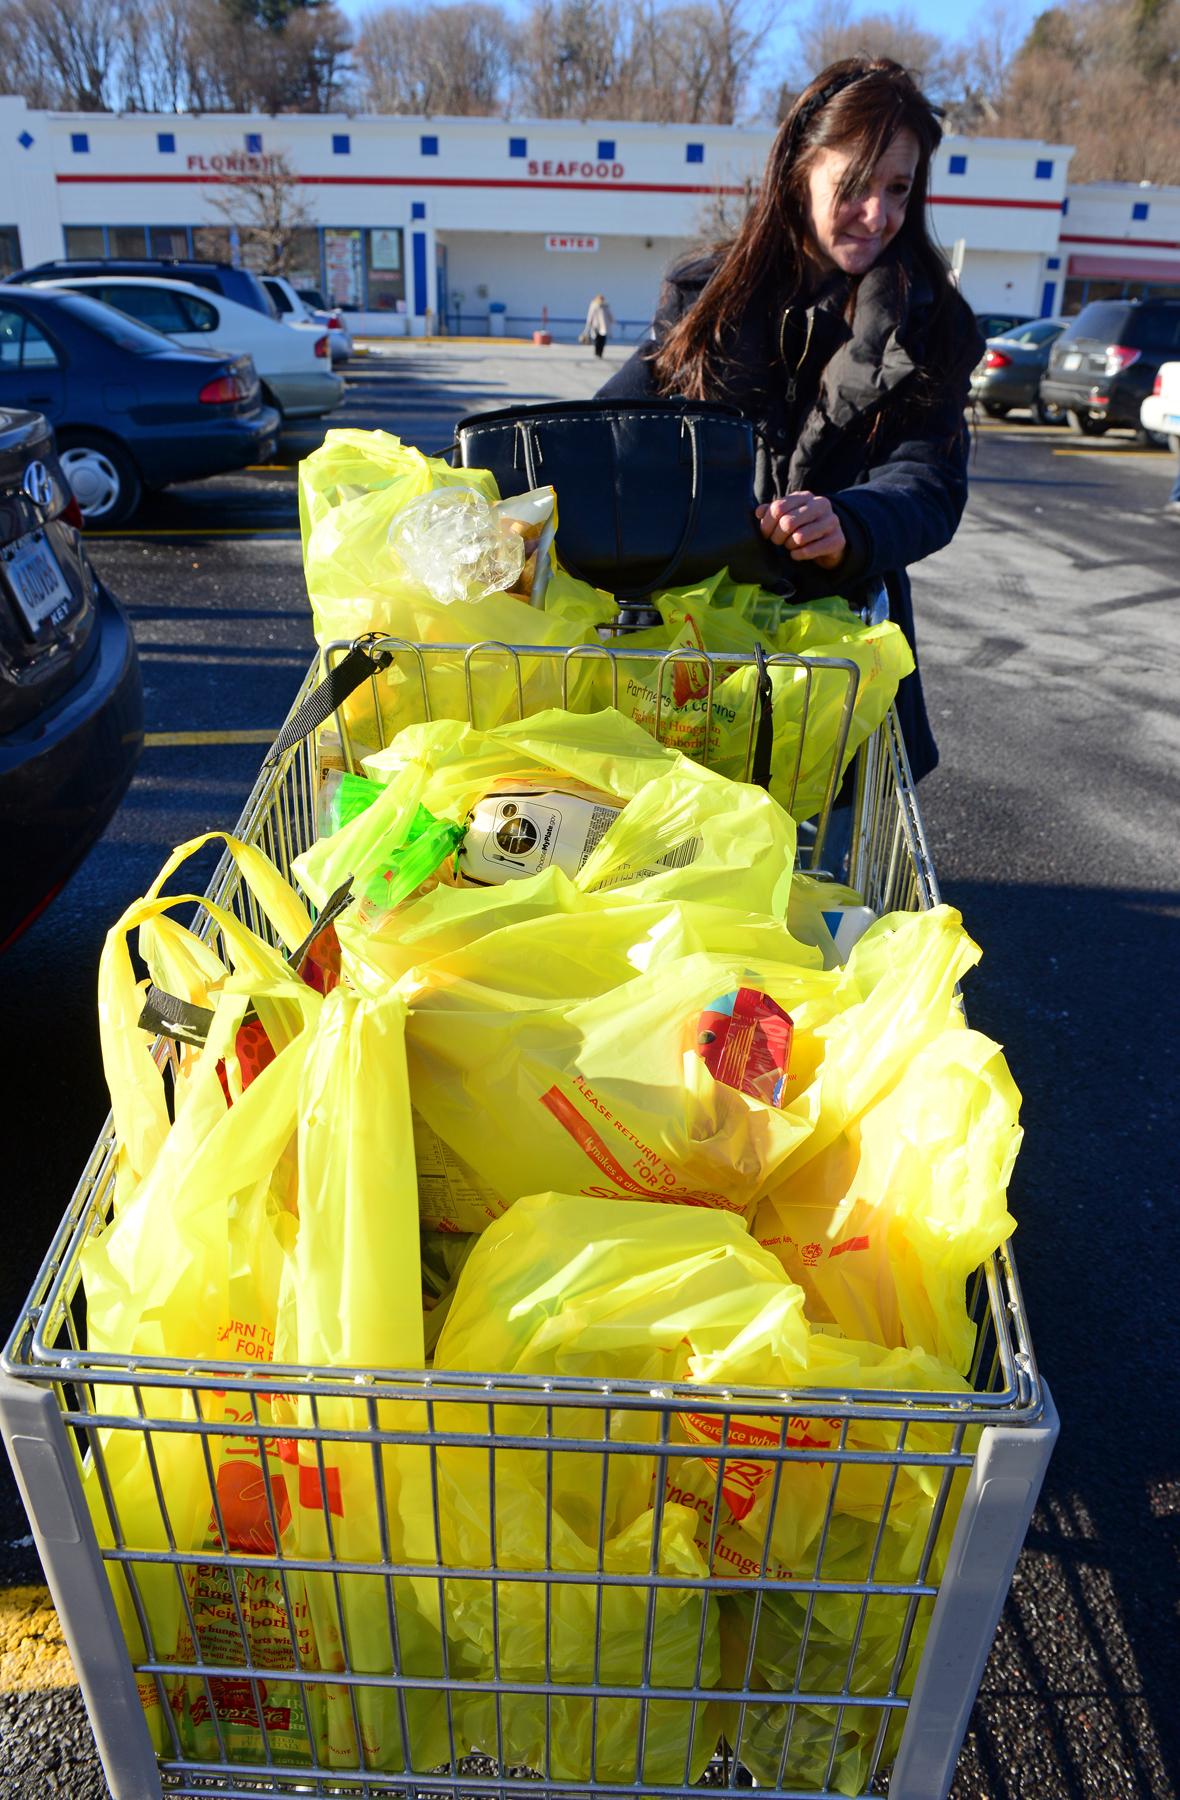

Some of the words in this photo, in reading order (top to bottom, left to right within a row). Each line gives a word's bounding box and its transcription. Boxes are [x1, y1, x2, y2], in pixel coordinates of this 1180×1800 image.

[528, 161, 624, 178] SEAFOOD
[549, 238, 595, 248] ENTER
[573, 1074, 614, 1121] PLEASE
[613, 1120, 662, 1167] RETURN
[658, 1163, 676, 1186] TO
[591, 1145, 617, 1176] makes
[633, 1158, 658, 1187] FOR
[236, 1338, 265, 1361] FOR
